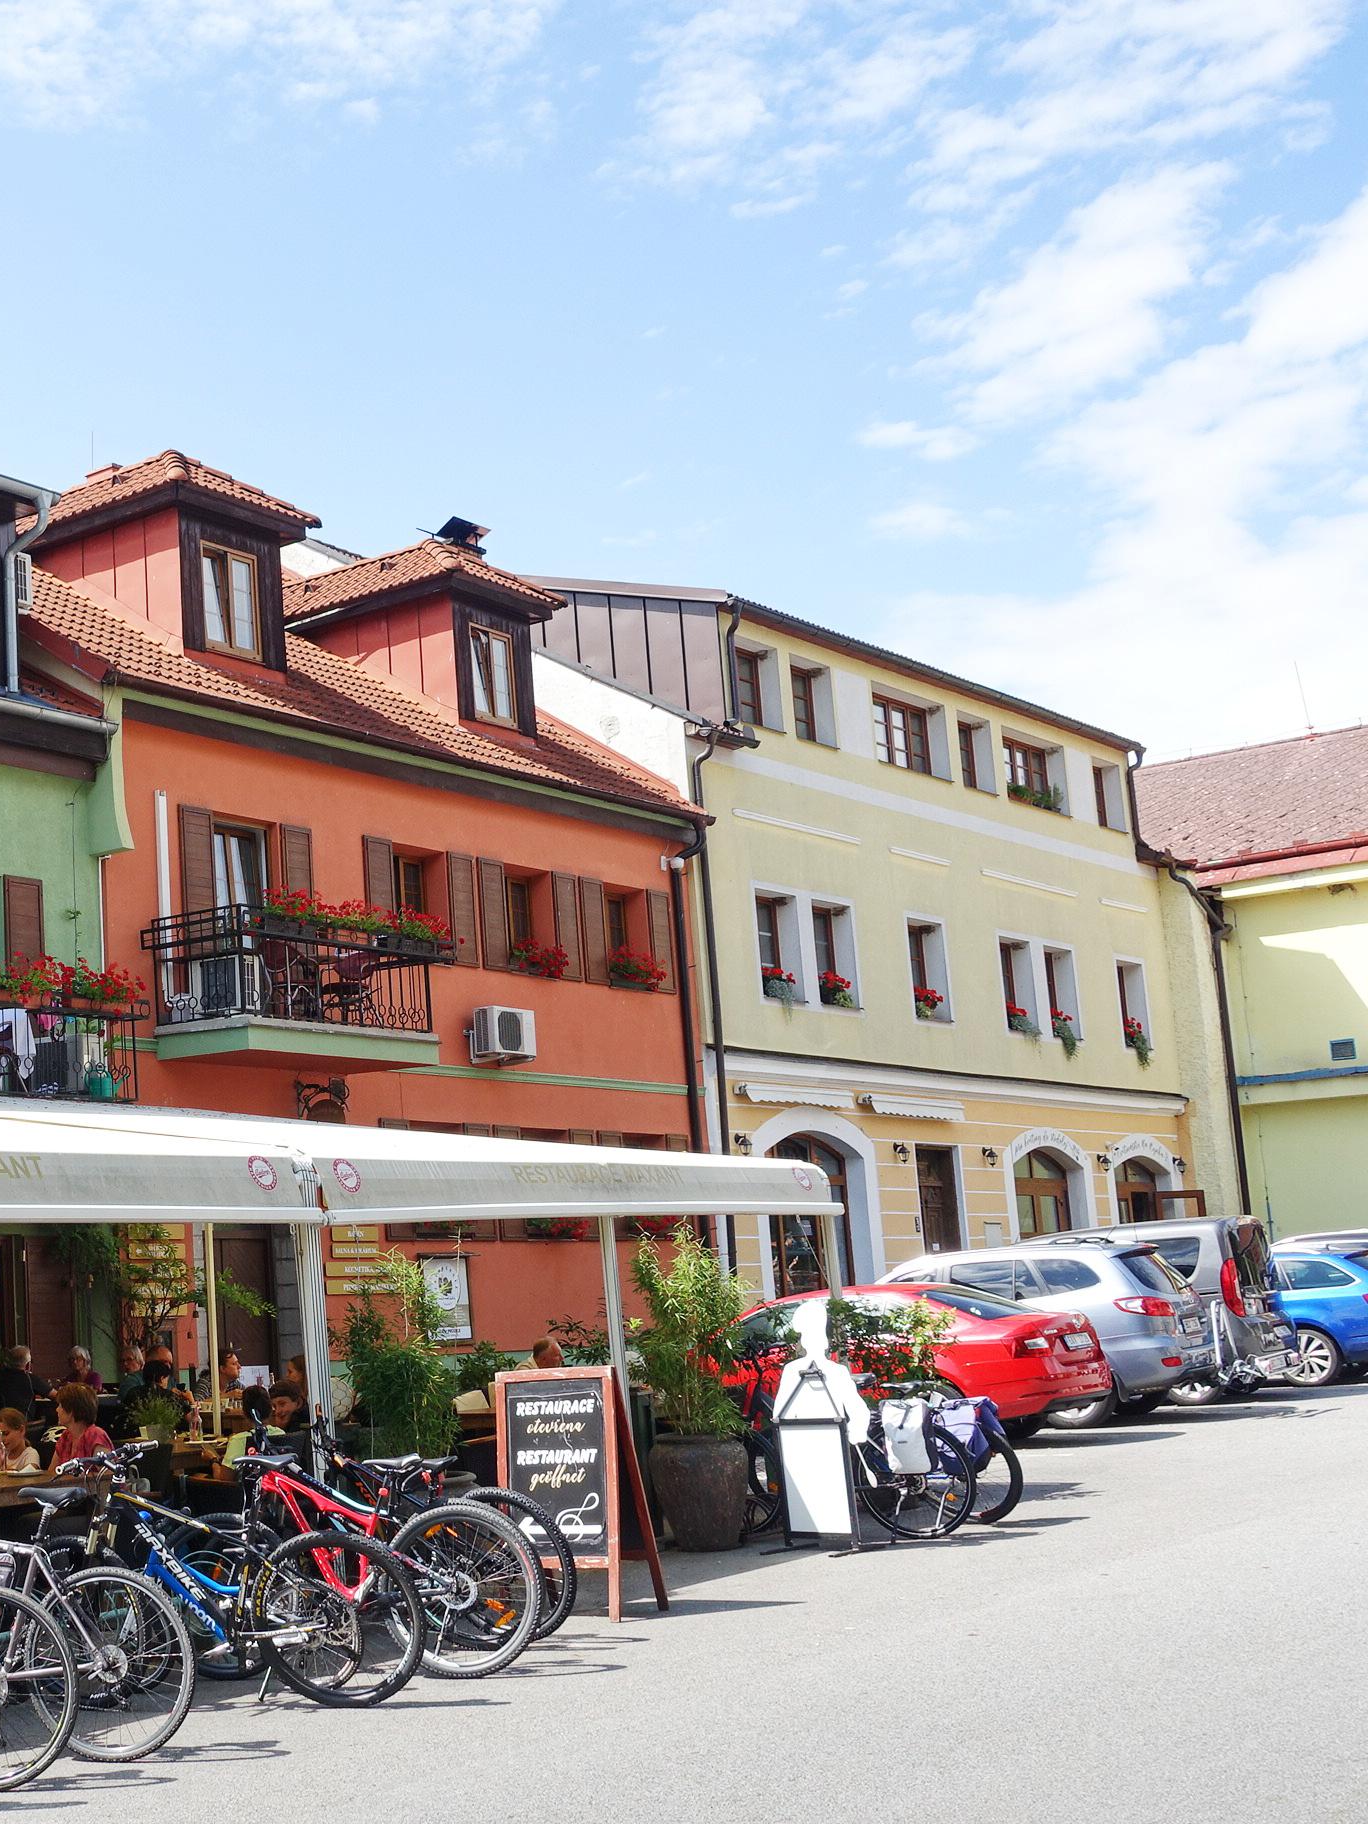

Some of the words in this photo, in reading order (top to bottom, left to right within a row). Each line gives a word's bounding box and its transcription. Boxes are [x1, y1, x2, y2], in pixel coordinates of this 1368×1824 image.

[510, 1165, 623, 1184] RESTAURACE
[624, 1166, 685, 1185] MAXANT
[516, 1399, 594, 1416] RESTAURACE
[526, 1419, 586, 1434] otevřena
[517, 1448, 598, 1465] RESTAURANT
[529, 1465, 586, 1492] geöffnet
[134, 1522, 207, 1601] MAXBIKE
